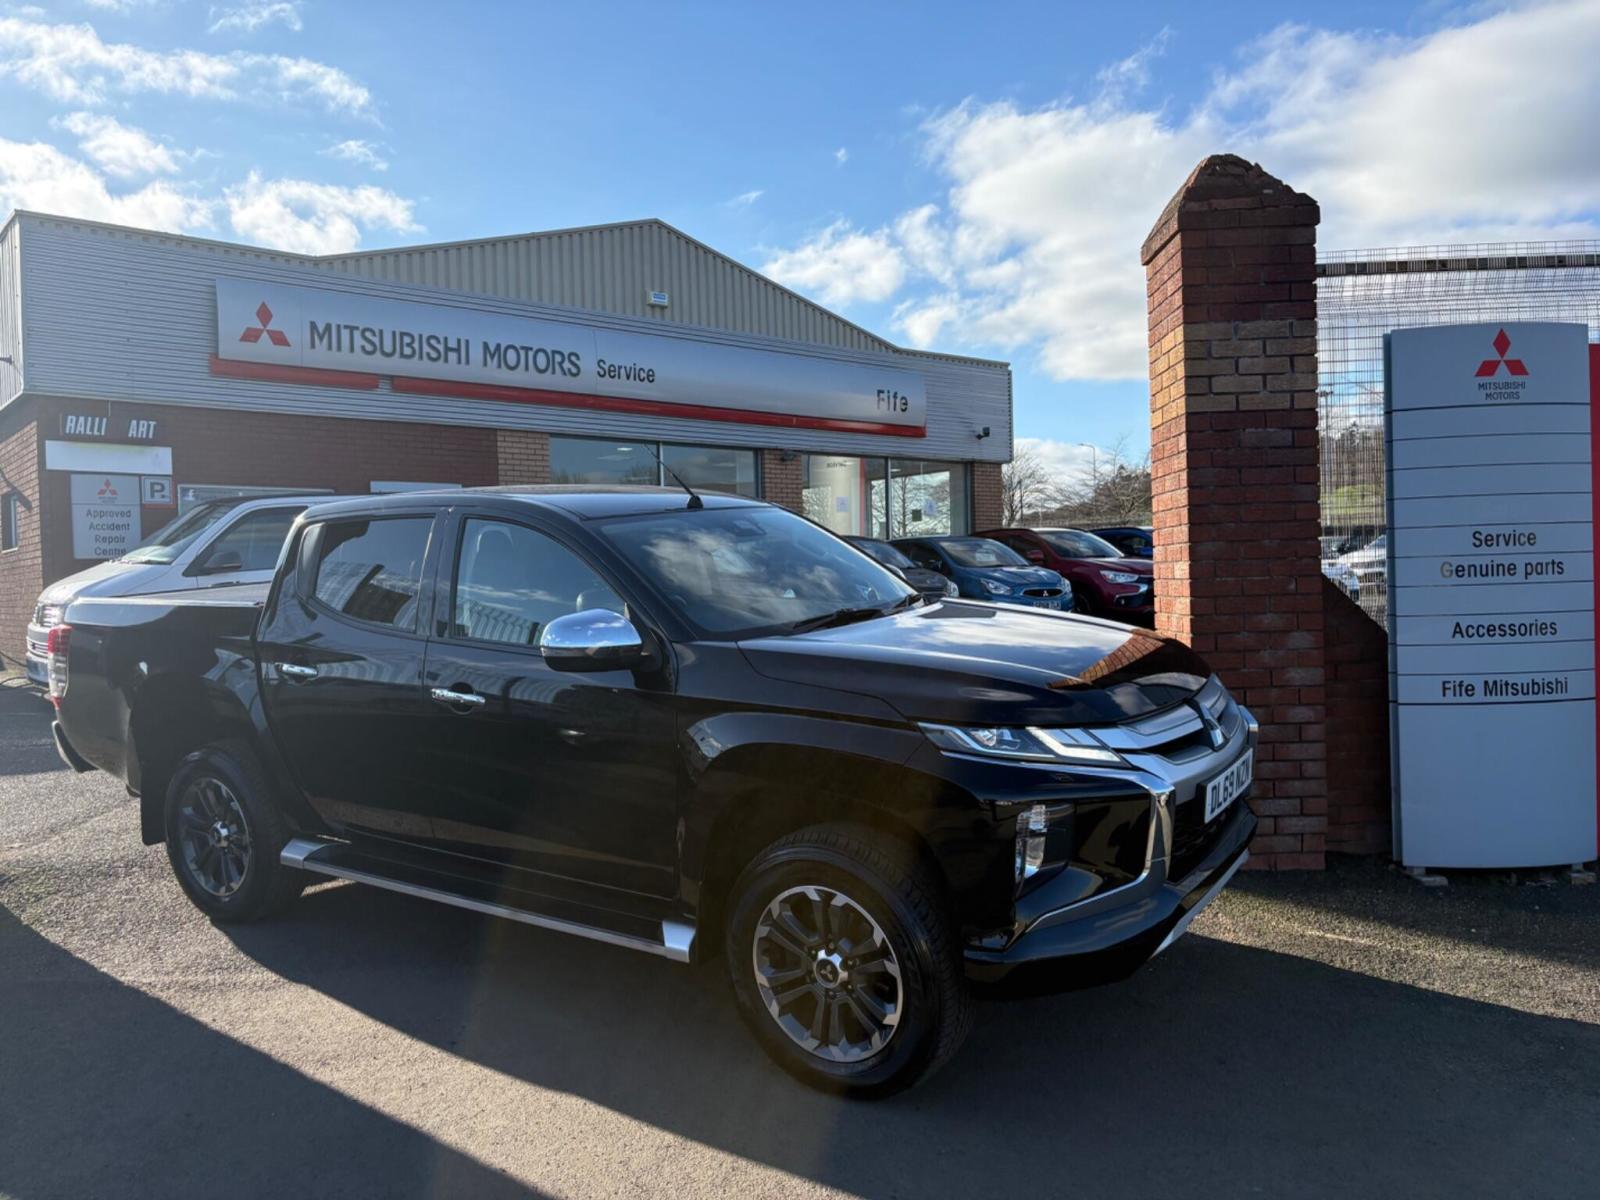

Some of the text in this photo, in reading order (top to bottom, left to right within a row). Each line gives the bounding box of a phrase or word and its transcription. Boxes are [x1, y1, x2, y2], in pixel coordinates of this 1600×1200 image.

[309, 320, 656, 384] MITSUBISHI MOTORS Service
[1477, 381, 1526, 391] MITSUBISHI
[1485, 391, 1520, 400] MOTORS
[876, 388, 909, 413] Fife
[65, 415, 157, 439] RALLI ART
[150, 482, 165, 499] P
[86, 509, 132, 519] Approved
[89, 522, 130, 531] Accident
[94, 534, 126, 544] Repair
[1472, 530, 1537, 548] Service
[1440, 559, 1565, 580] Genuine parts
[1452, 619, 1558, 639] Accessories
[1442, 677, 1569, 698] Fife Mitsubishi
[1210, 770, 1235, 815] DL69
